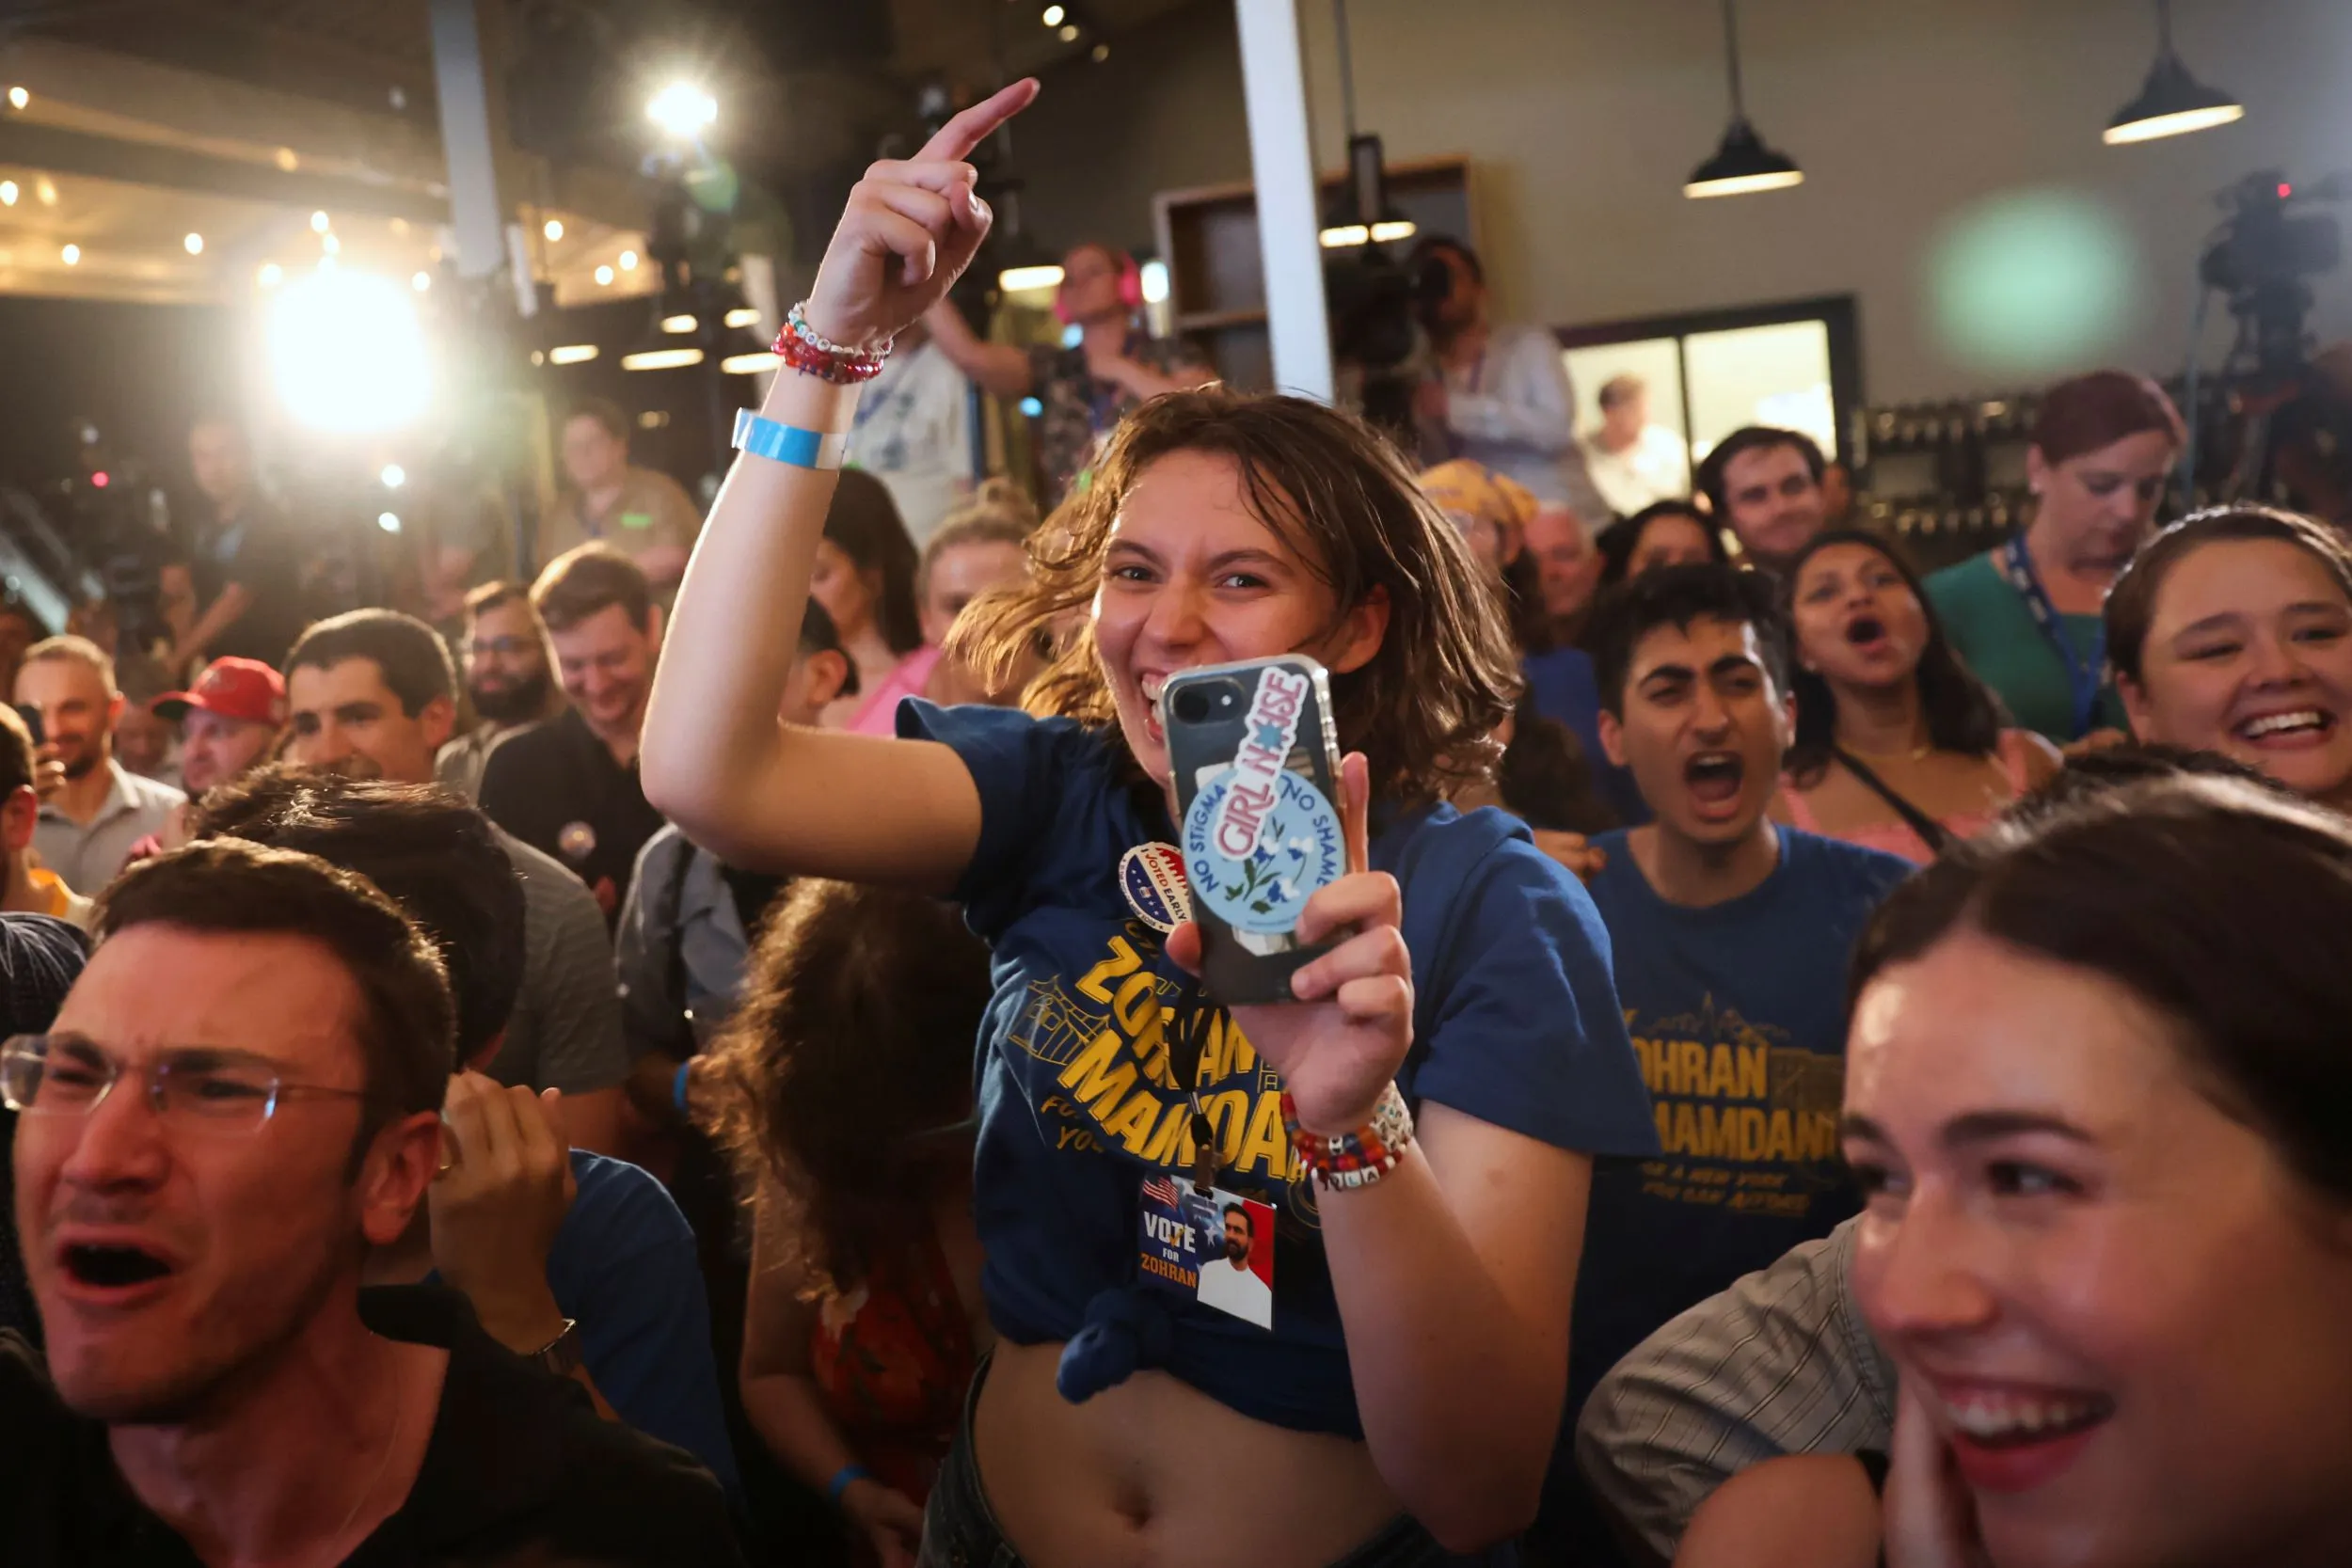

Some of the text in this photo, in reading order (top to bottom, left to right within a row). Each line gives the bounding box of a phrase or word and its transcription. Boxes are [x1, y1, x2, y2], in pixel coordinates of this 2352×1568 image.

[1217, 783, 1275, 856] GIRL
[1279, 774, 1337, 885] NO SHAME
[1194, 860, 1219, 893] NO
[1144, 1212, 1196, 1253] VOTE
[1140, 1252, 1198, 1289] ZOHRAN
[1163, 1247, 1179, 1262] FOR
